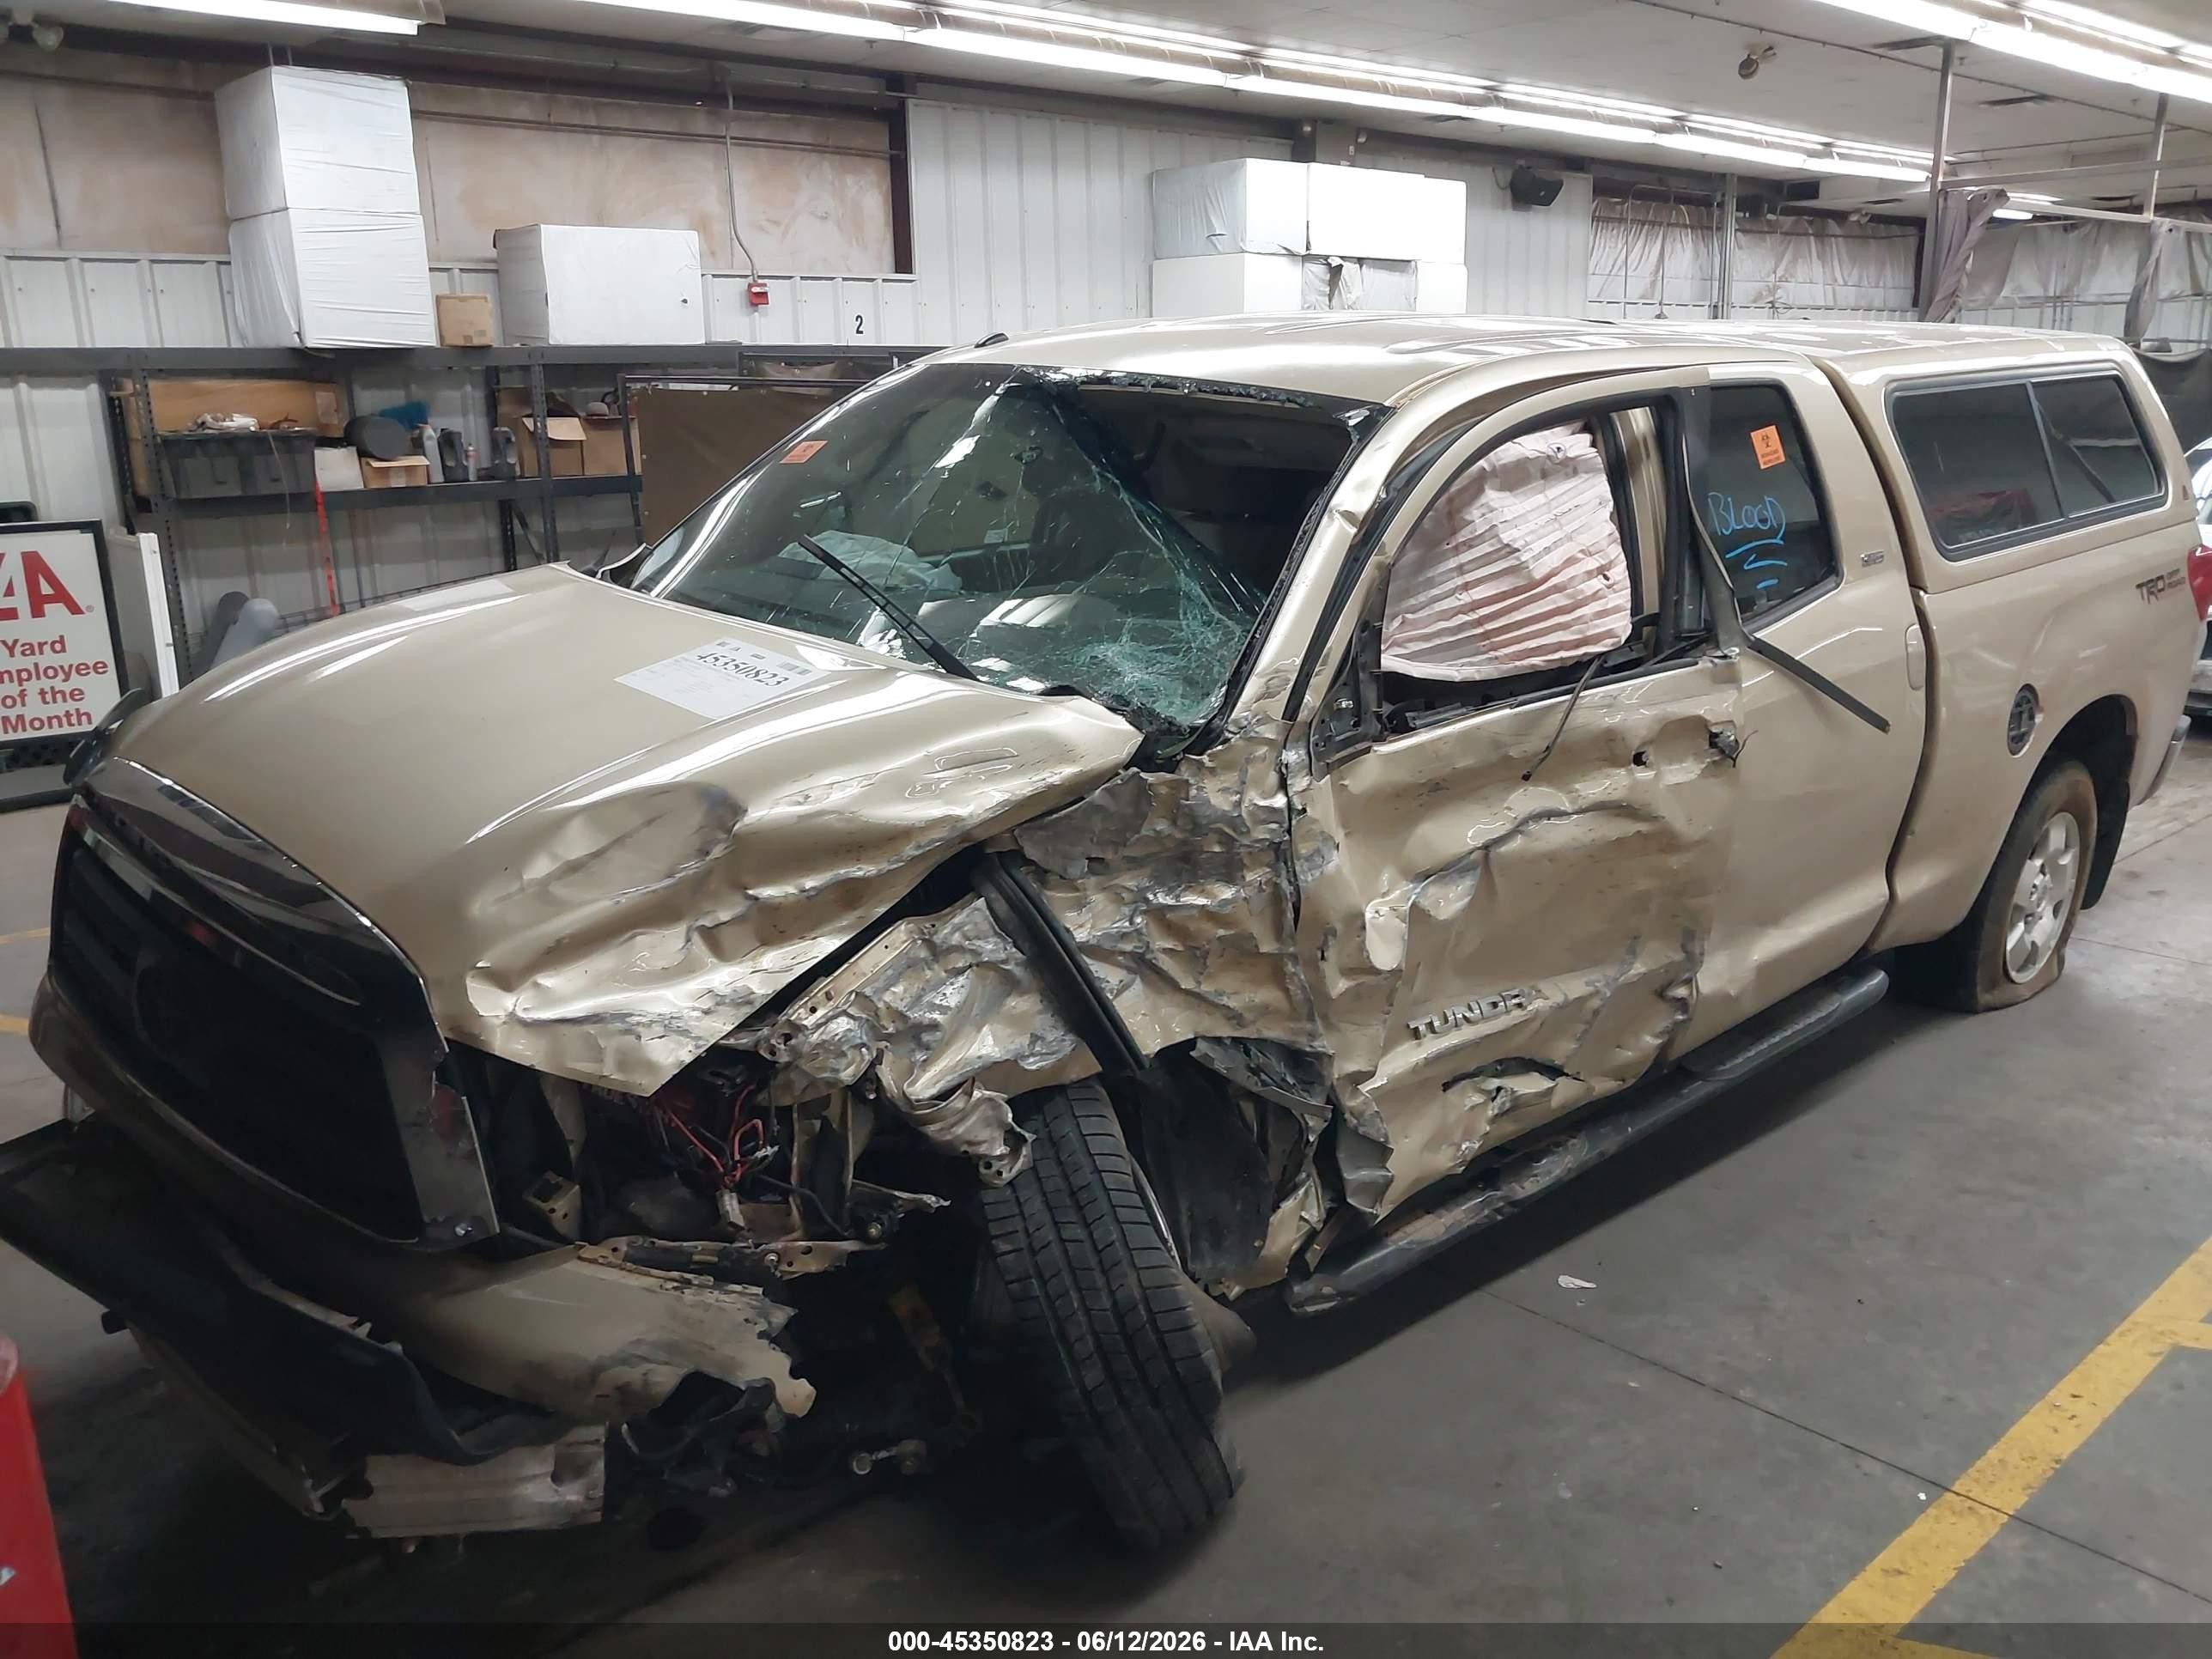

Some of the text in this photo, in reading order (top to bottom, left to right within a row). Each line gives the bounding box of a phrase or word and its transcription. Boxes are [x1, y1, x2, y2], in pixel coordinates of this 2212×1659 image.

[855, 314, 864, 334] 2
[2136, 574, 2166, 605] TRD
[1, 635, 67, 658] Yard
[696, 653, 789, 687] 45350823
[1, 687, 86, 708] of the
[1, 708, 93, 734] Month
